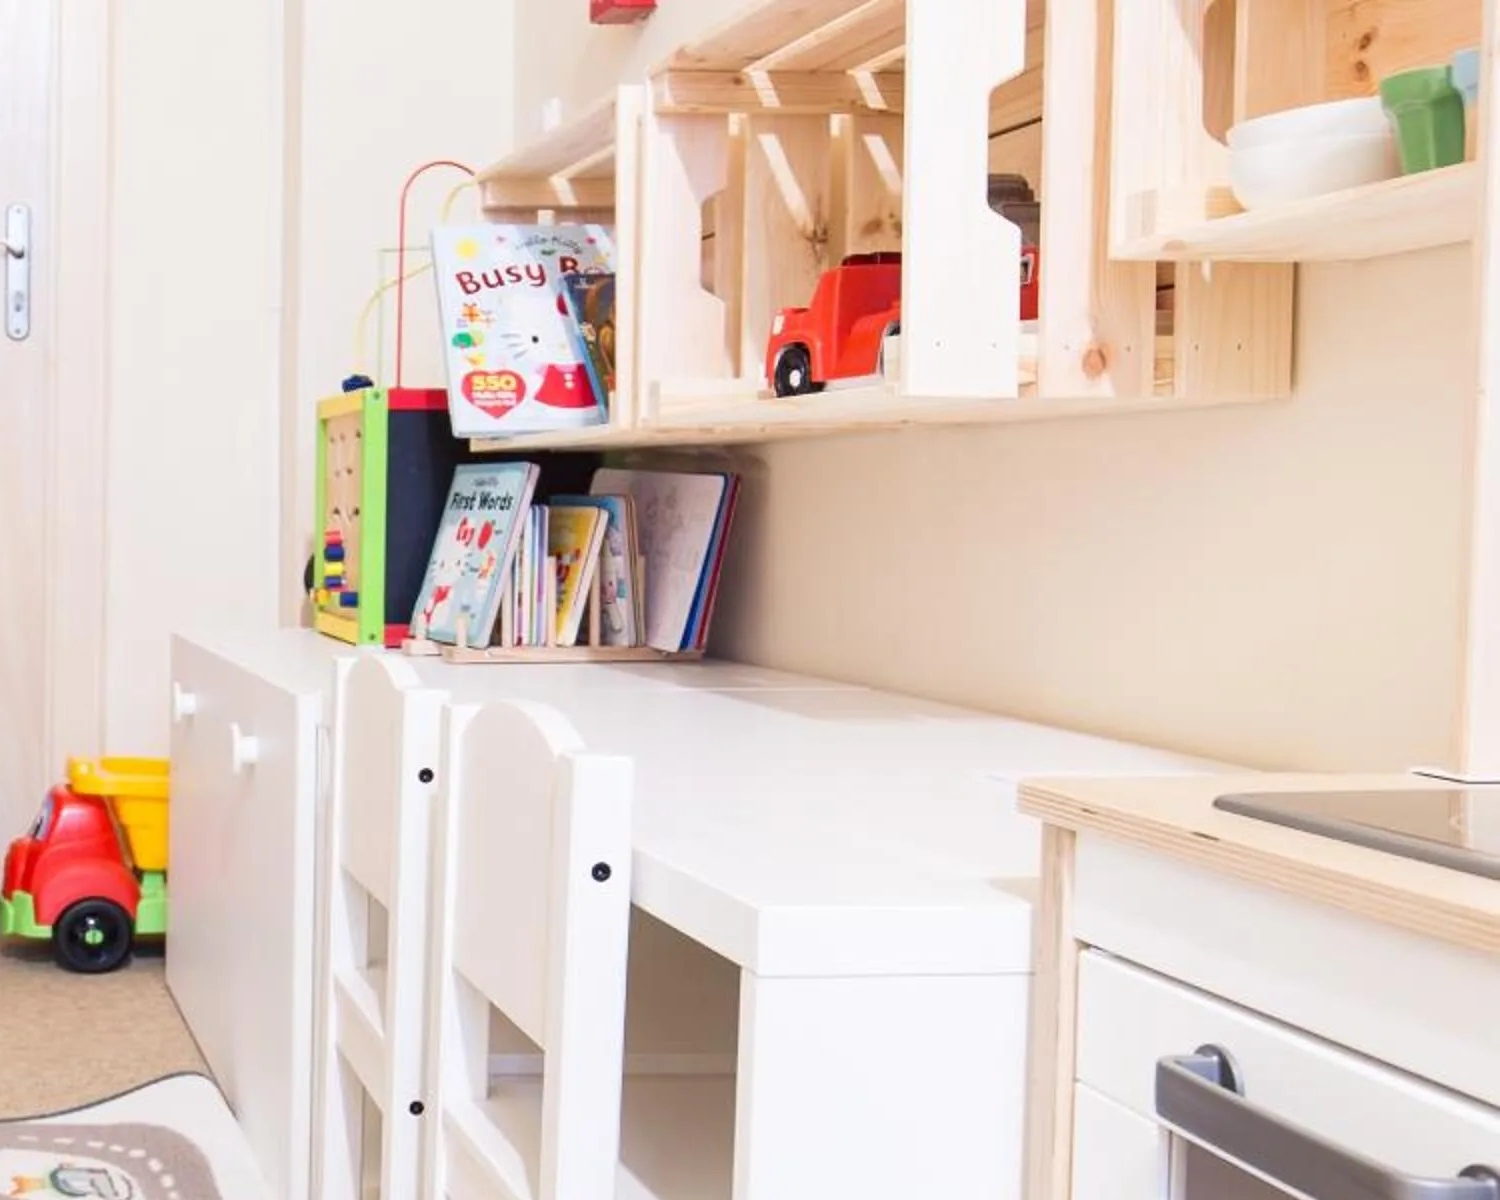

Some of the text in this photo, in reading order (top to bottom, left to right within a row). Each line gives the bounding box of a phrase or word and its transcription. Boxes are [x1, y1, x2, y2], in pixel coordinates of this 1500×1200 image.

[455, 263, 547, 296] Busy
[450, 490, 514, 511] First Words
